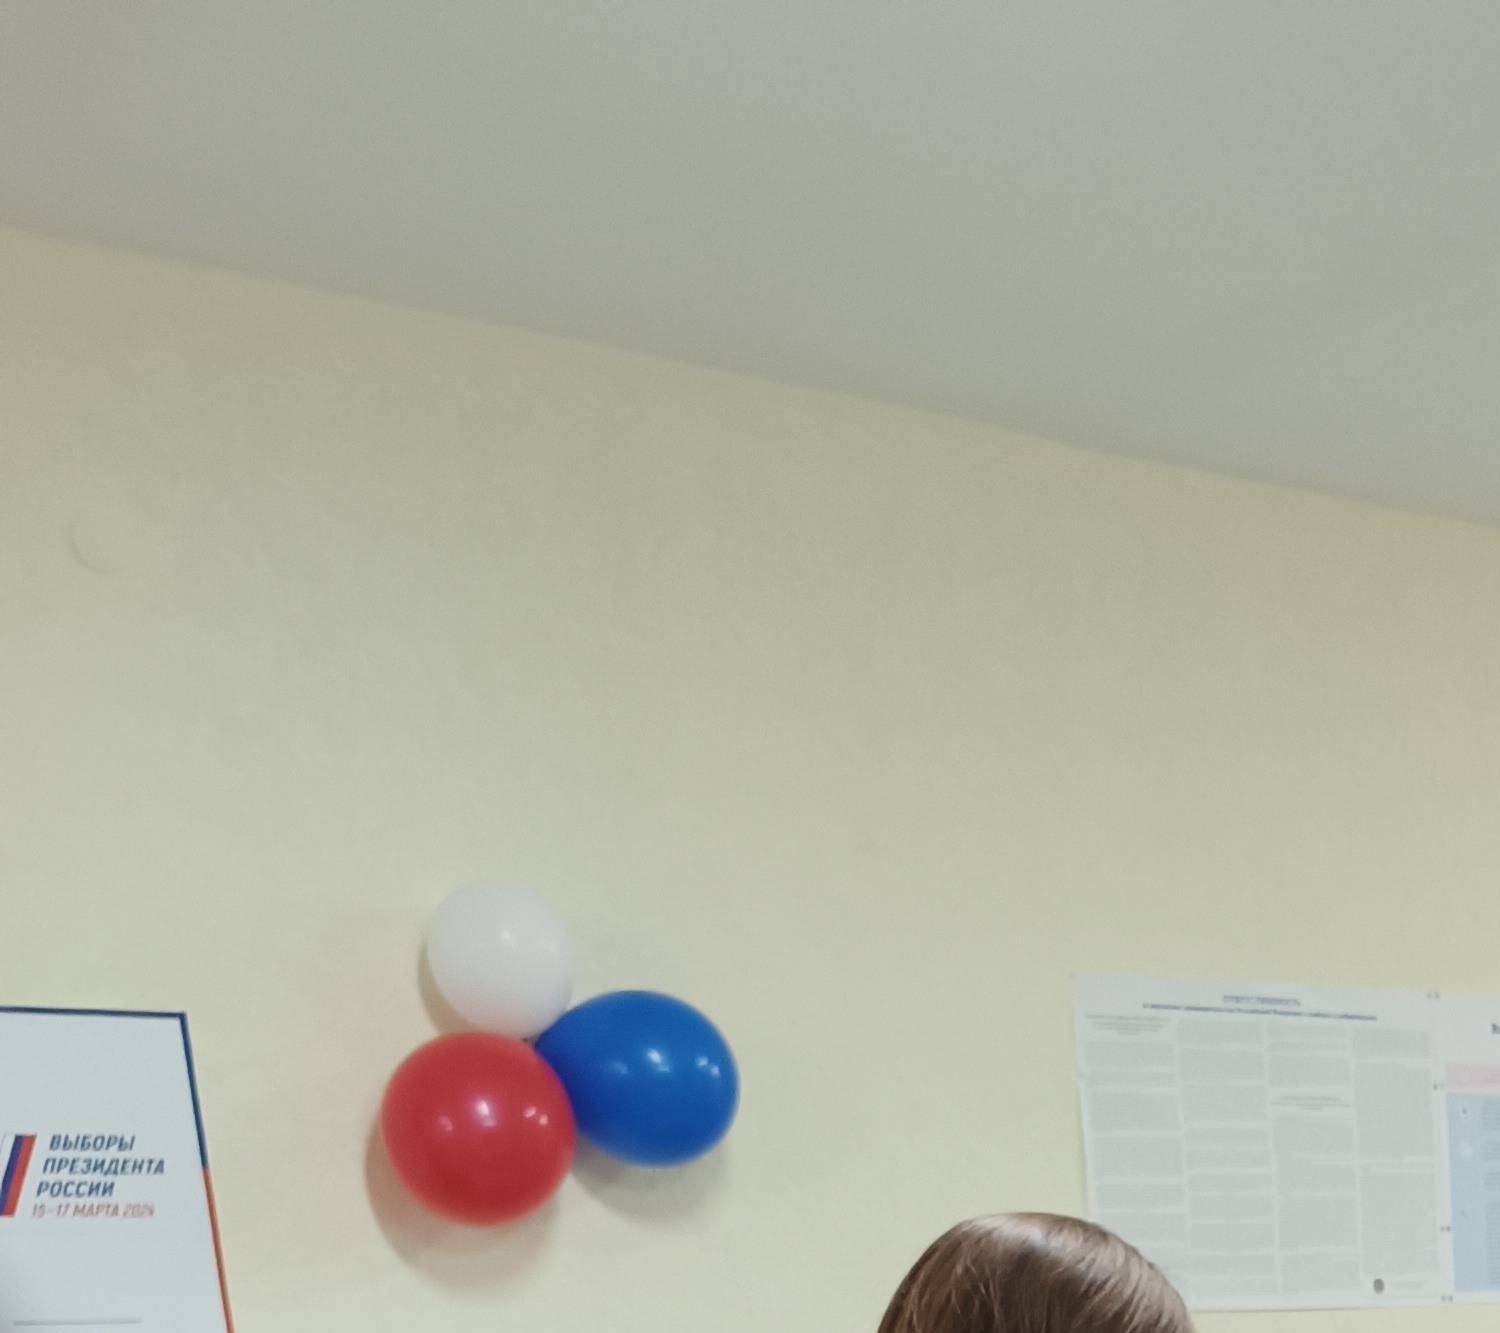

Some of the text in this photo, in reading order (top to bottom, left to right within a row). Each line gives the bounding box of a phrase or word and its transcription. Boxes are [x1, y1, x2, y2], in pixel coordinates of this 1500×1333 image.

[49, 1134, 136, 1152] ВЫБОРЫ
[42, 1157, 165, 1176] ПРЕЗИДЕНТА
[36, 1180, 115, 1198] РОССИИ
[72, 1203, 119, 1218] МАРТА
